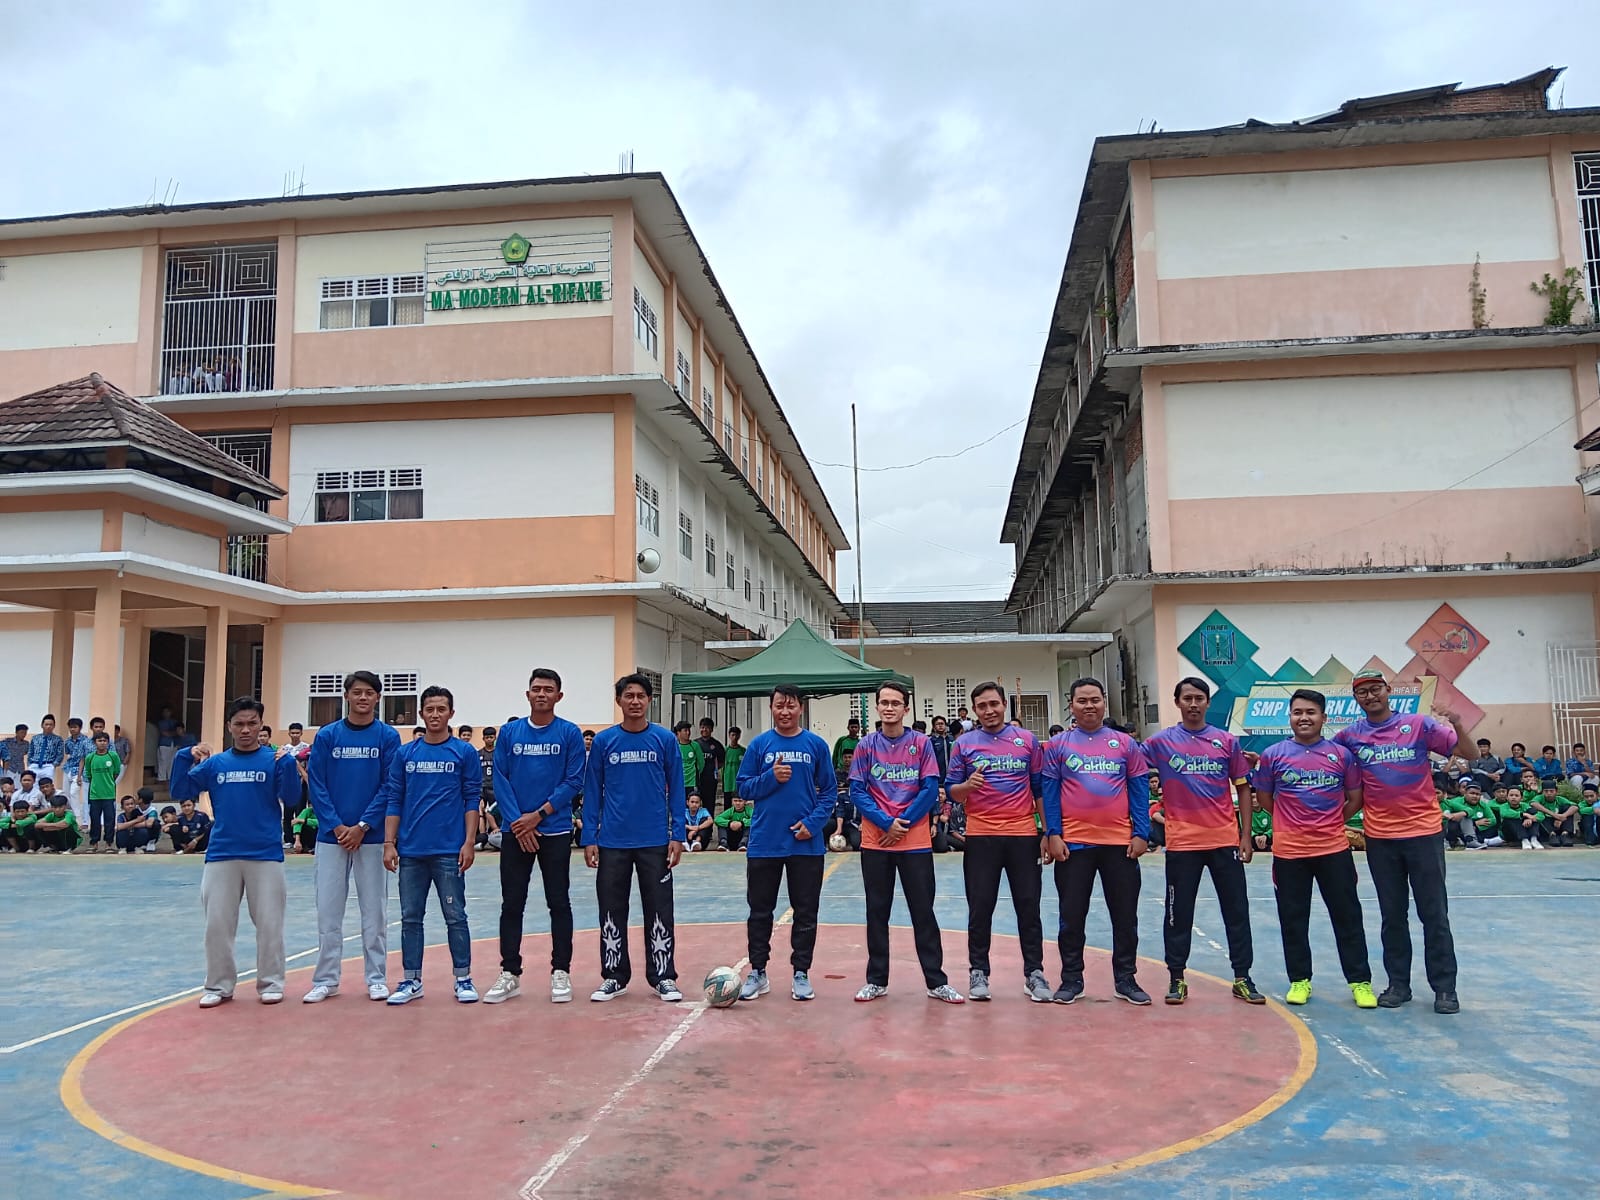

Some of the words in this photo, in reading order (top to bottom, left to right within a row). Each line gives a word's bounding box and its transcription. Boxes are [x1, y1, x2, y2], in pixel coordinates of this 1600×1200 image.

[432, 290, 453, 310] MA
[460, 286, 519, 308] MODERN
[526, 280, 602, 304] AL-RIFA'IE
[1251, 701, 1284, 716] SMP
[486, 766, 492, 775] 6
